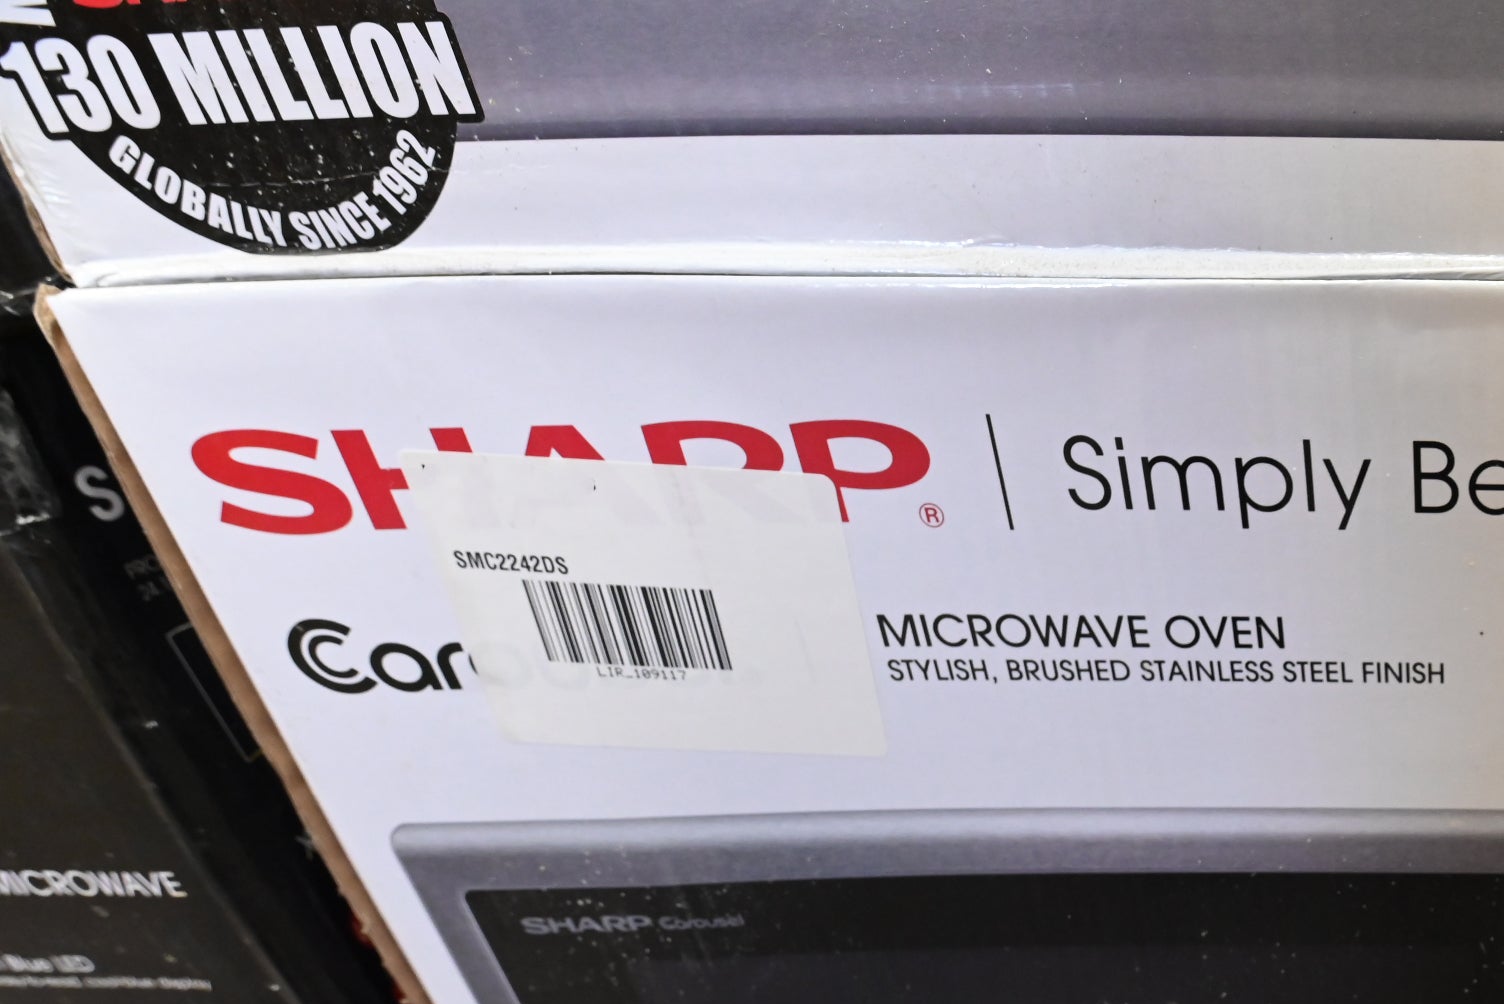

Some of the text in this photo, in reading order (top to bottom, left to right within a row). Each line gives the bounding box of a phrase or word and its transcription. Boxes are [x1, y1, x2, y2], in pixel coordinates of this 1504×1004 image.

[0, 21, 474, 134] 130 MILLION
[109, 129, 436, 251] GLOBALLY SINCE 1962
[1060, 433, 1371, 531] Simply
[453, 550, 570, 576] SMC2242DS
[876, 613, 1287, 650] MICROWAVE OVEN
[886, 658, 1446, 685] STYLISH, BRUSHED STAINLESS STEEL FINISH
[520, 915, 651, 935] SHARP
